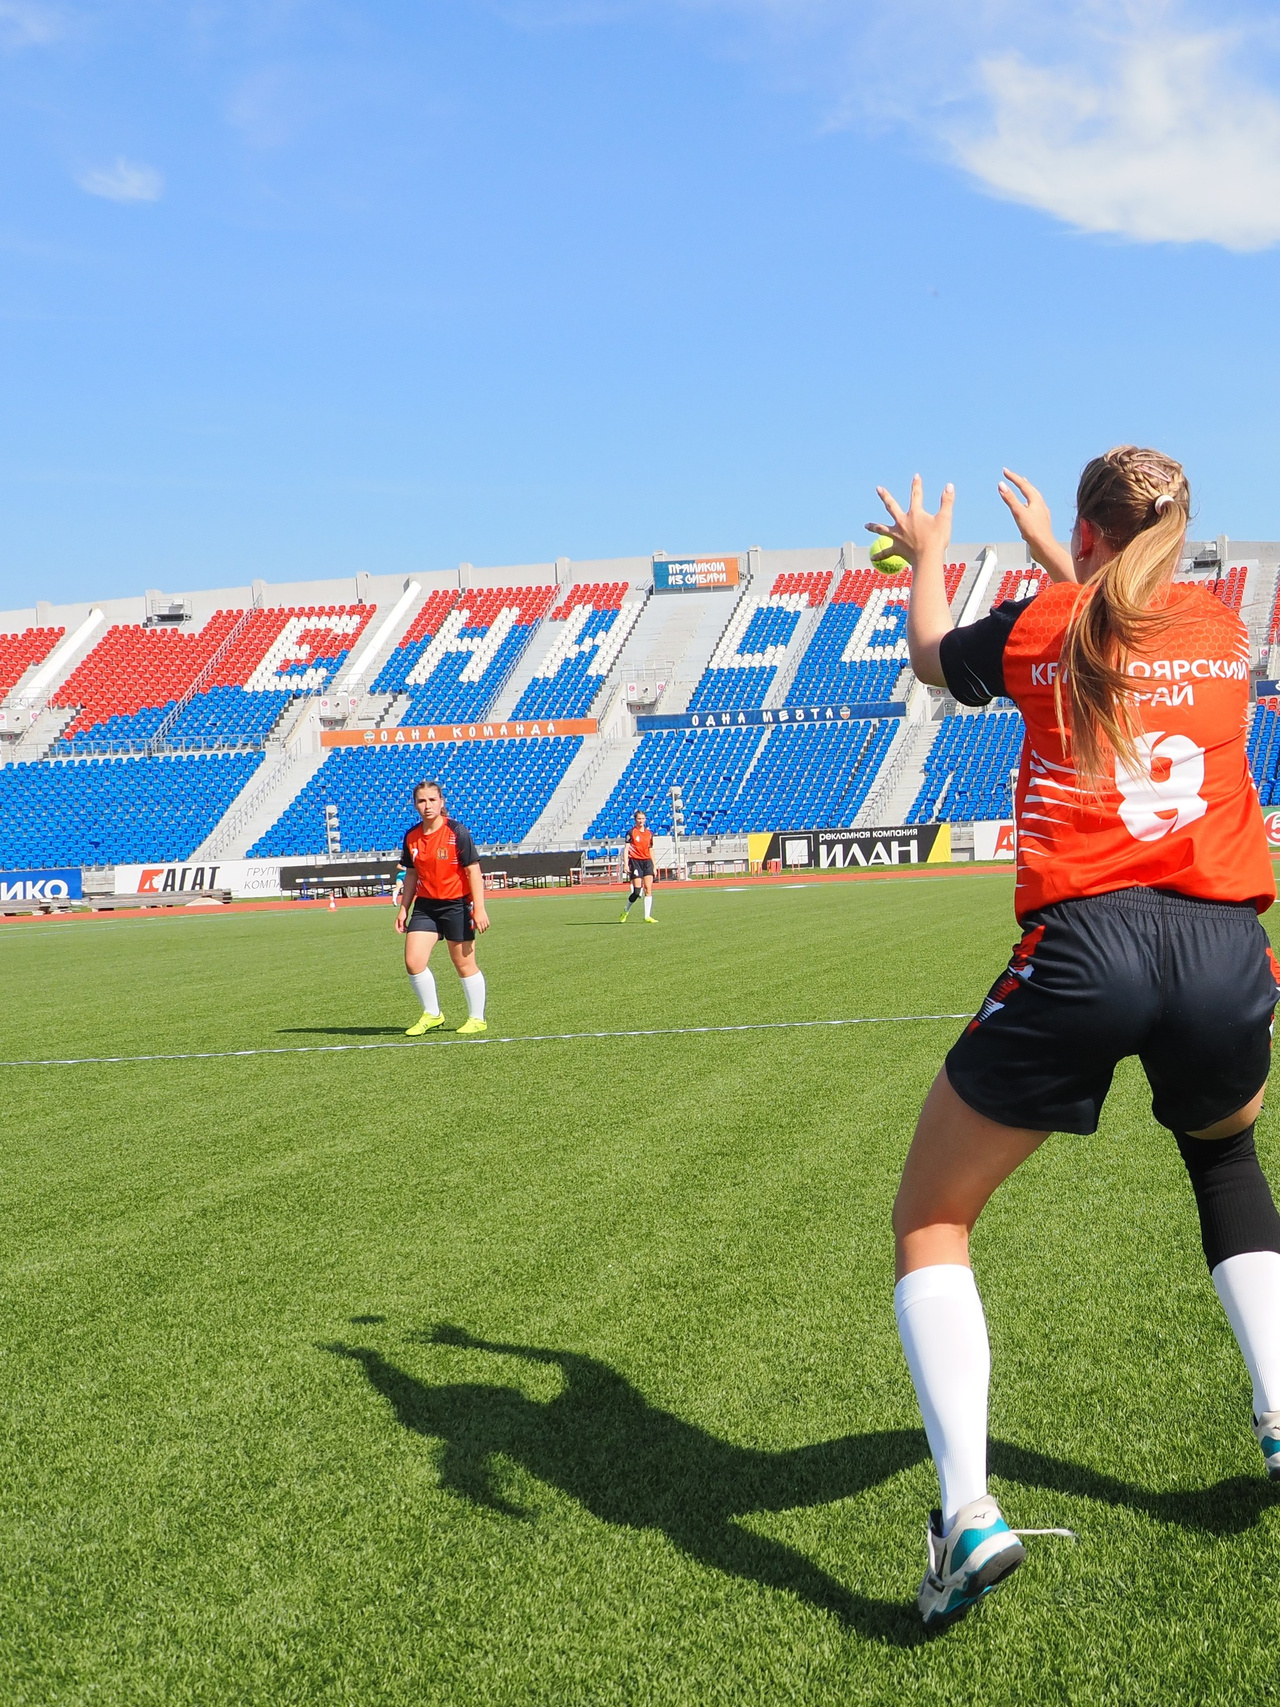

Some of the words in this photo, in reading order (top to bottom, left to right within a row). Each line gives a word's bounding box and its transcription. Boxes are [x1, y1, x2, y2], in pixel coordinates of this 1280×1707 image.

[668, 561, 725, 574] ПРЯМИКОМ
[668, 574, 684, 585] ИЗ
[685, 572, 727, 584] СИБИРИ
[691, 712, 746, 727] ОДНА
[762, 707, 834, 723] МЕЧТА
[380, 727, 436, 743] ОДНА
[452, 722, 555, 738] КОМАНДА
[819, 830, 871, 842] рекламная
[873, 828, 918, 839] компания
[819, 839, 919, 869] ИЛАН
[162, 866, 221, 892] АГАТ
